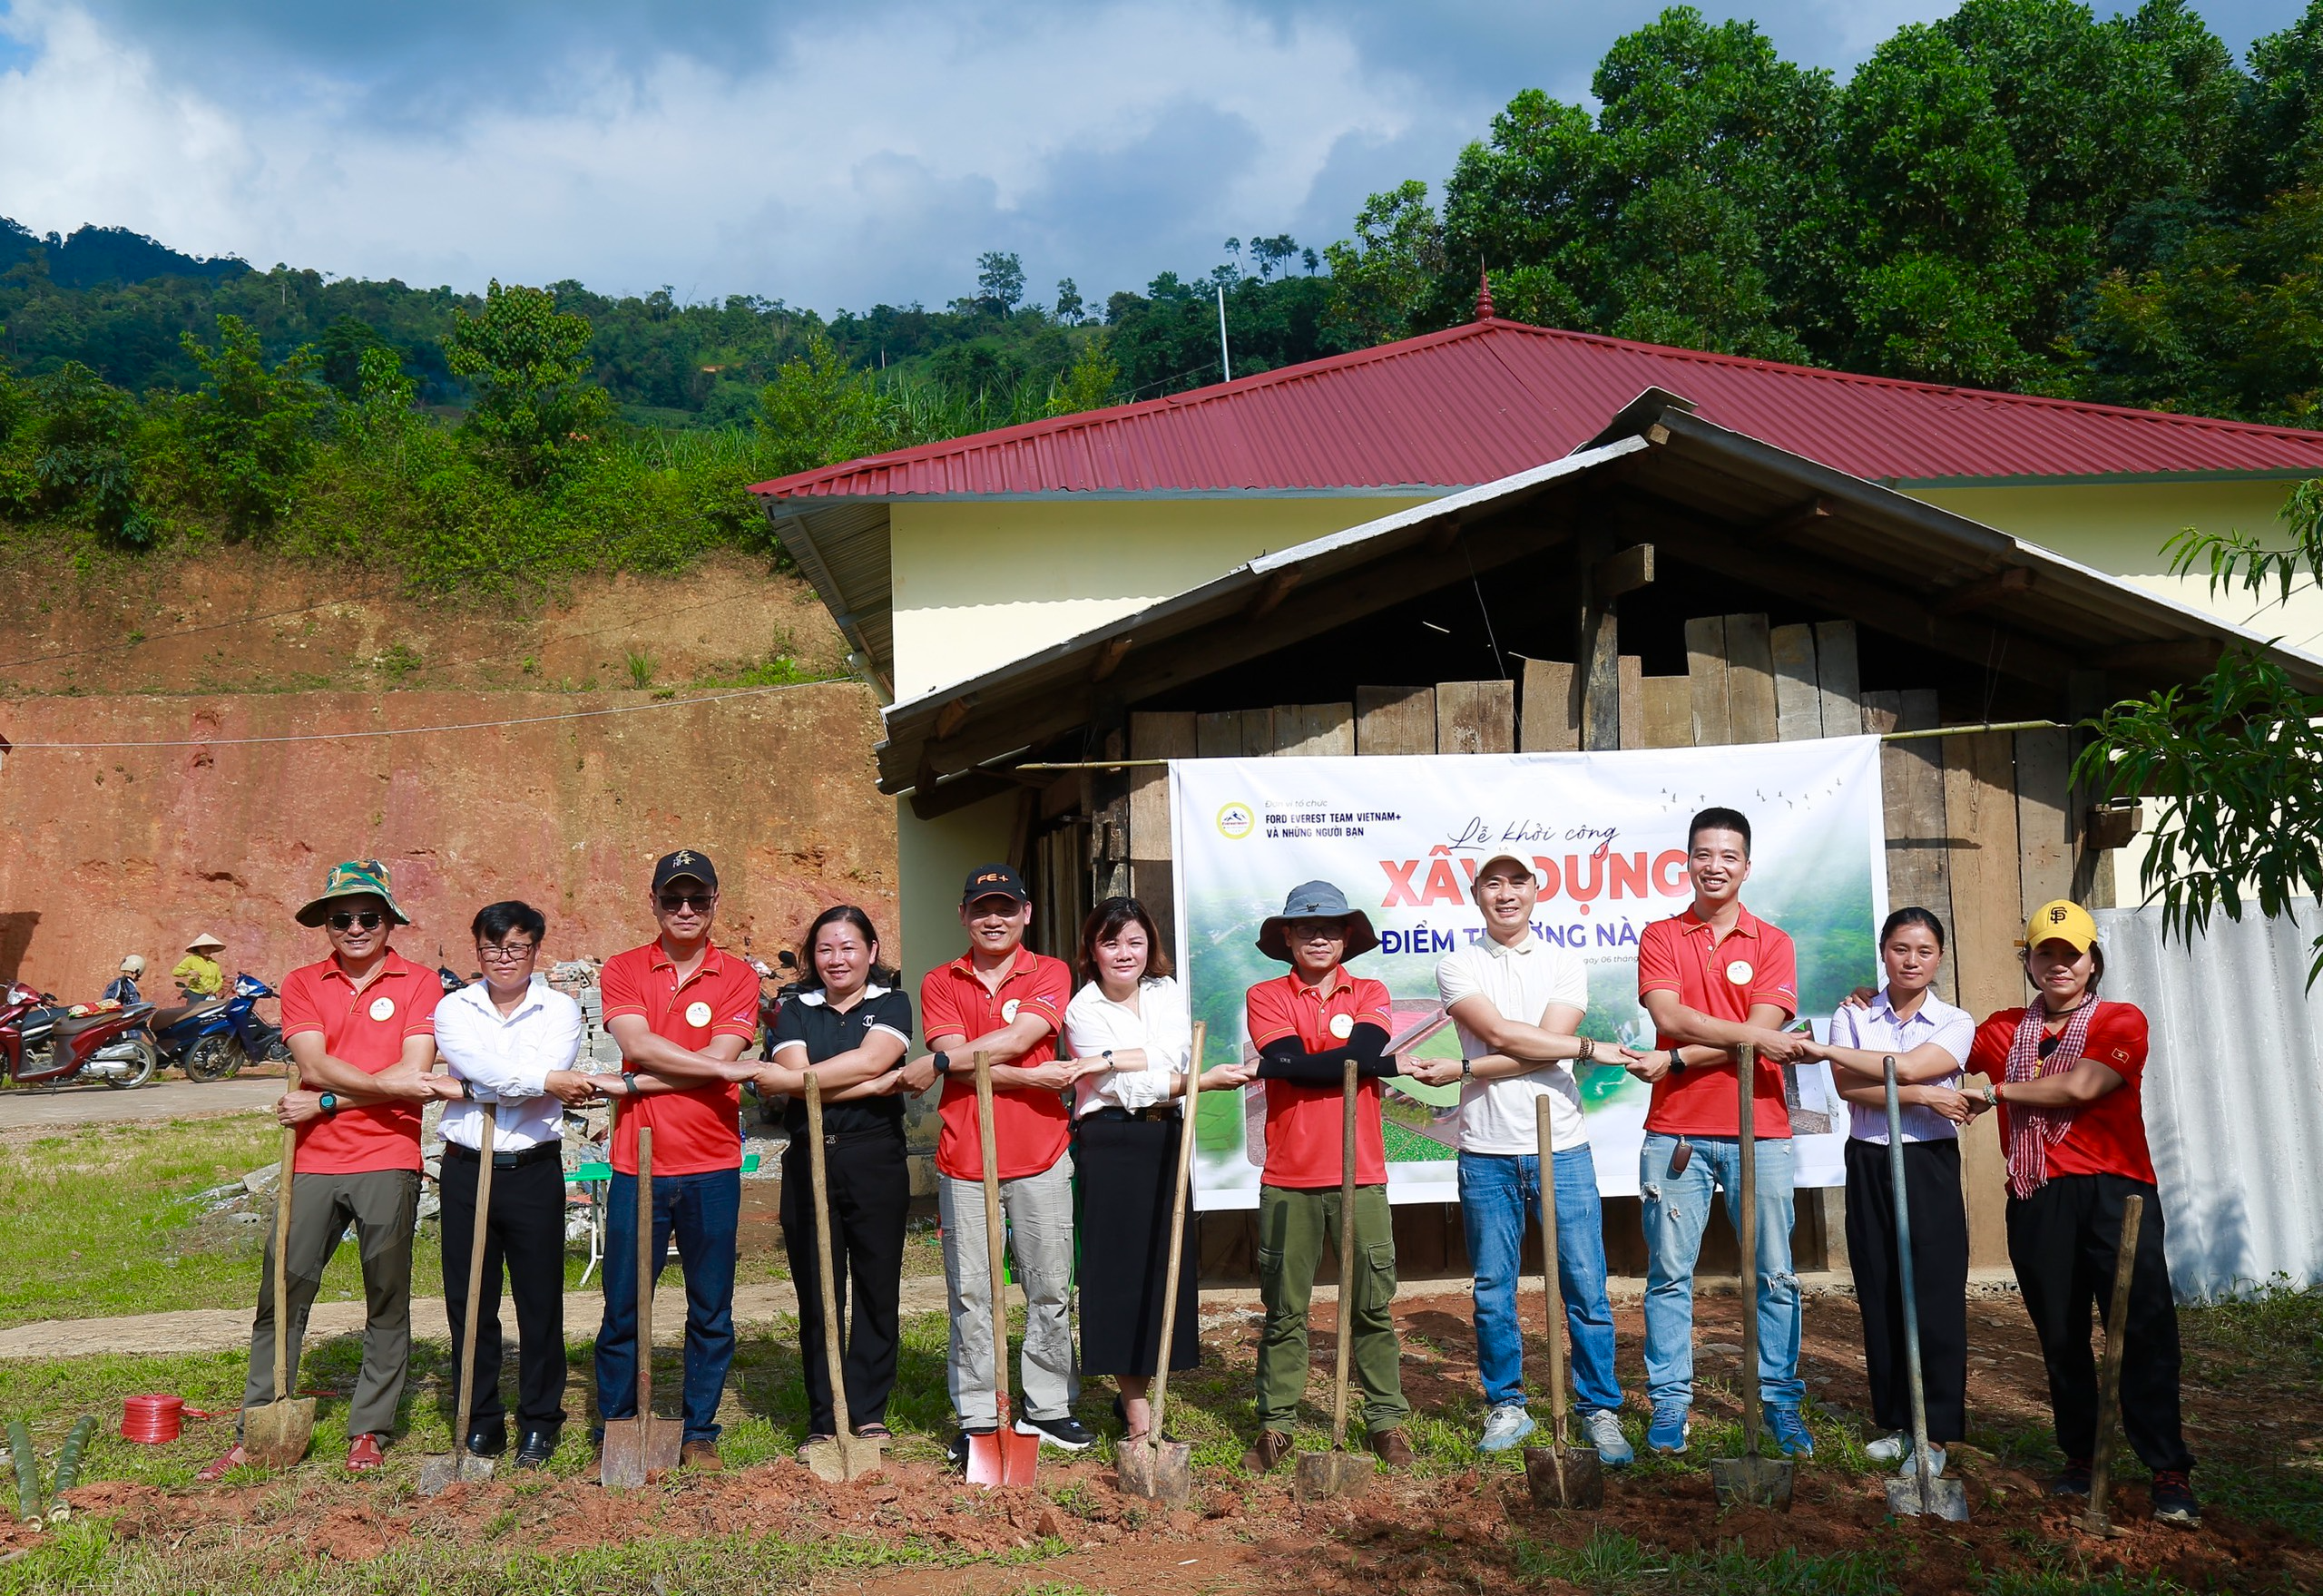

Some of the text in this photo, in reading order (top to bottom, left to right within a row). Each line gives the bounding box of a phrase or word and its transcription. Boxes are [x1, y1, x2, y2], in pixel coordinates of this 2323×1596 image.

[1266, 811, 1402, 824] FORD EVEREST TEAM VIETNAM+
[1267, 826, 1364, 839] VÀ NHỮNG NGƯỜI BẠN
[1447, 816, 1621, 859] Lễ khởi công
[976, 873, 1009, 885] FE+
[1380, 920, 1455, 954] ĐIỂM
[1596, 915, 1639, 946] NÀ
[1601, 955, 1612, 964] 06
